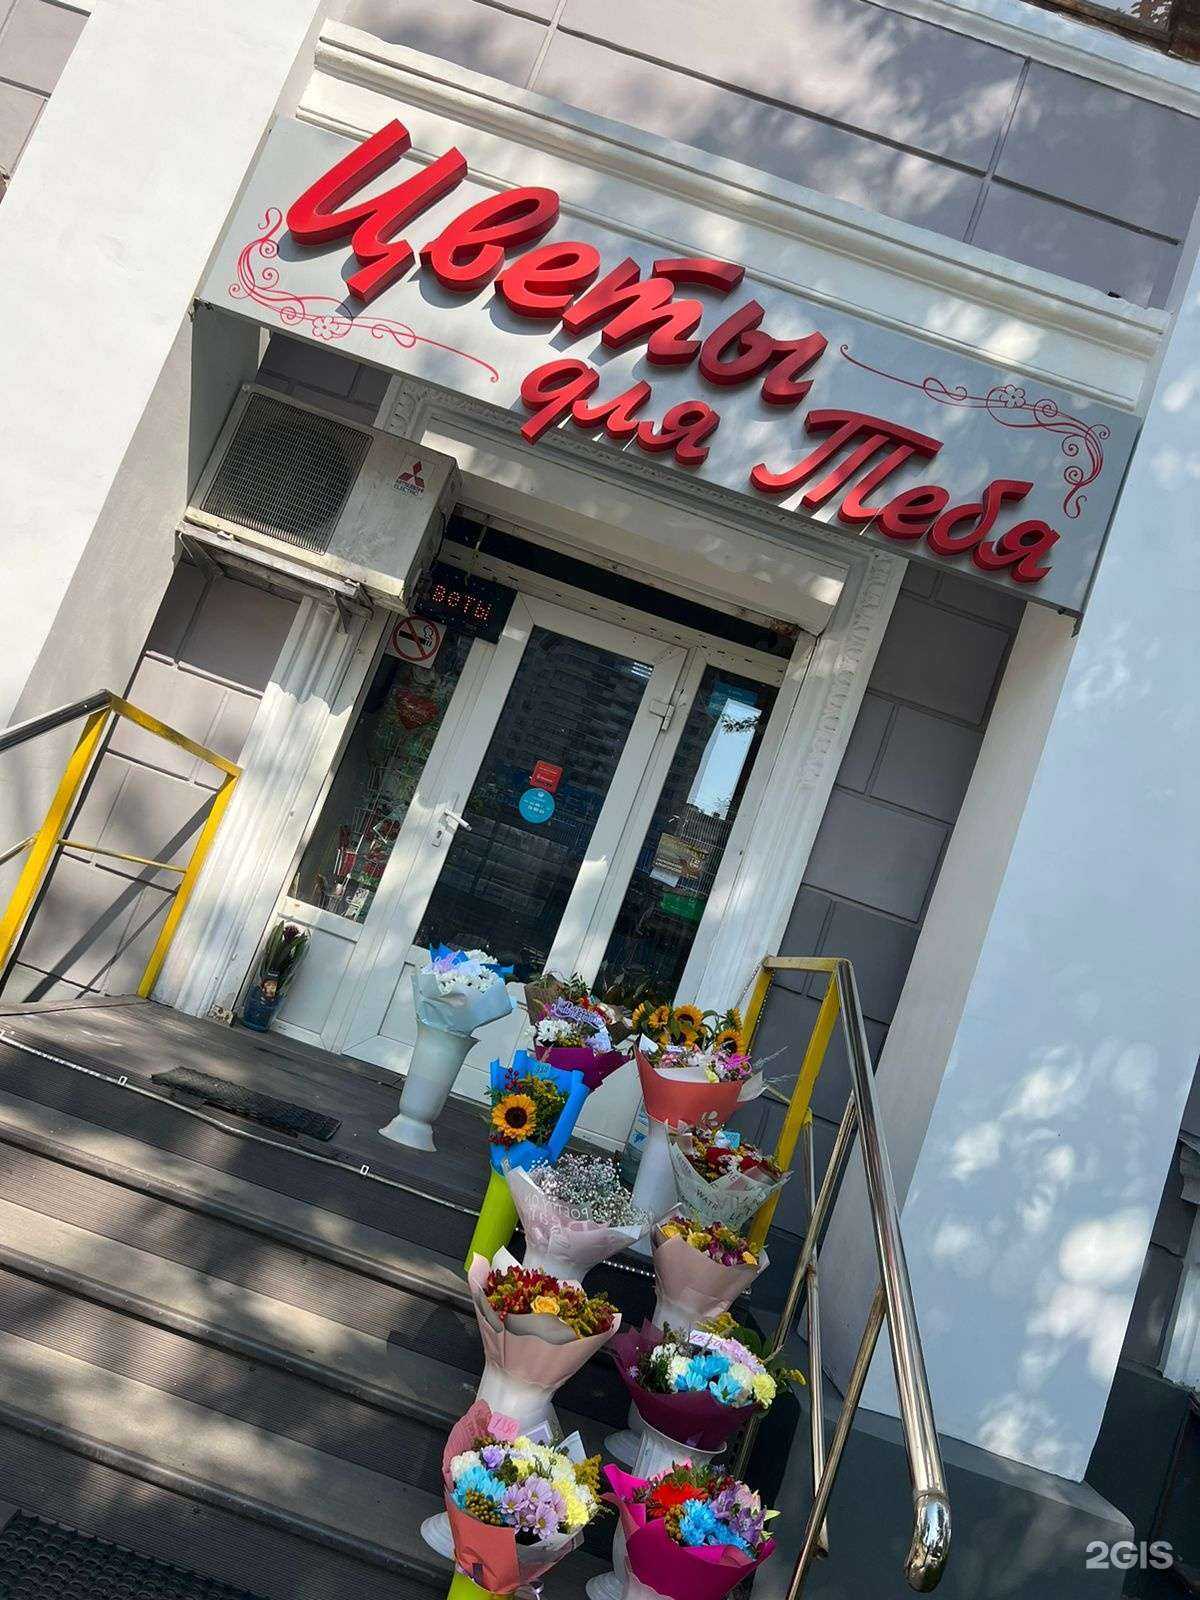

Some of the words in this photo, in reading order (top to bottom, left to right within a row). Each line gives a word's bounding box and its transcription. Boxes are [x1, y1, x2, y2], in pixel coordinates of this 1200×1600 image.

[287, 119, 828, 405] Цветы
[521, 359, 720, 466] для
[751, 410, 1060, 583] Тебя
